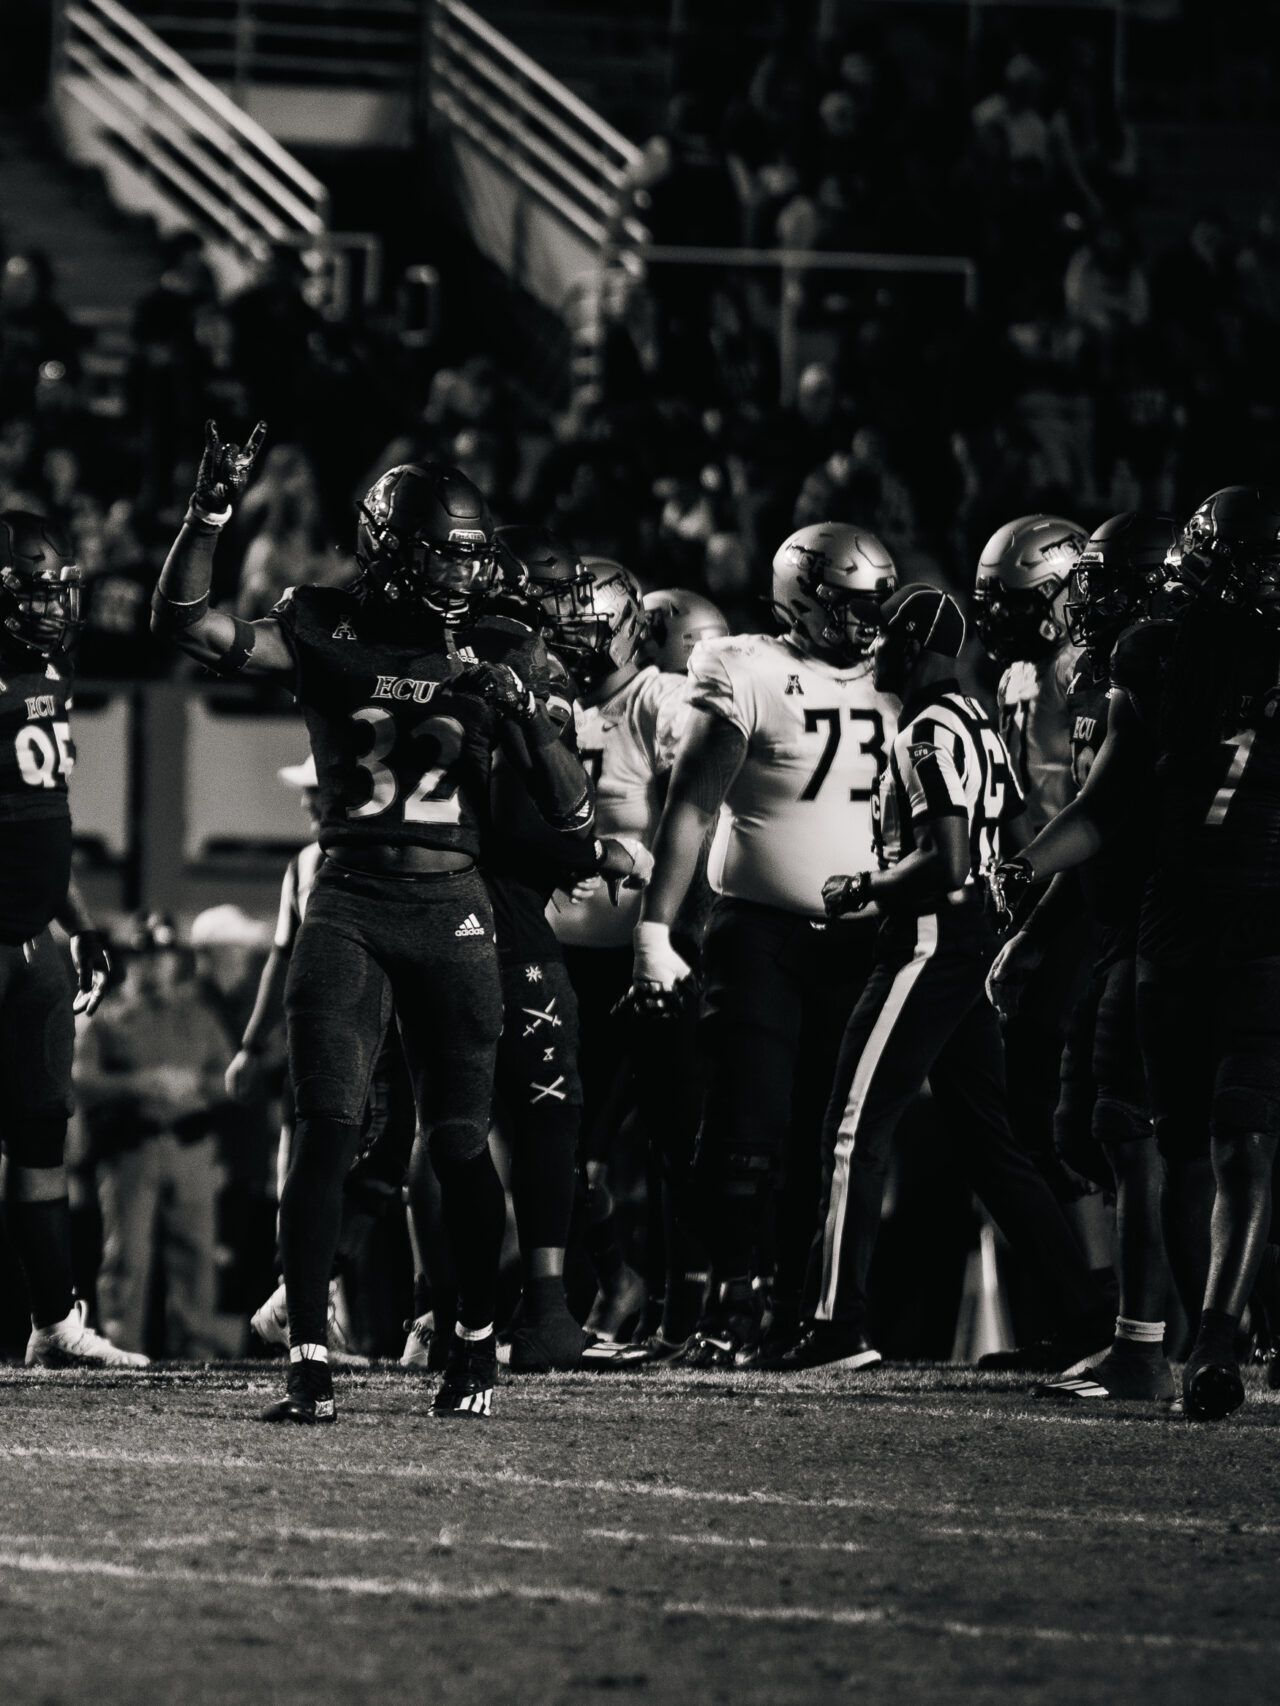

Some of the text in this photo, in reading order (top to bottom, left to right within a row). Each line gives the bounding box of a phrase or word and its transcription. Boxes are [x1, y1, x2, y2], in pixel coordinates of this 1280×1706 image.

[370, 675, 441, 704] ECU
[24, 695, 55, 720] ECU
[1072, 716, 1098, 742] ECU
[344, 705, 466, 826] 32
[798, 708, 888, 801] 73
[455, 927, 485, 937] adidas
